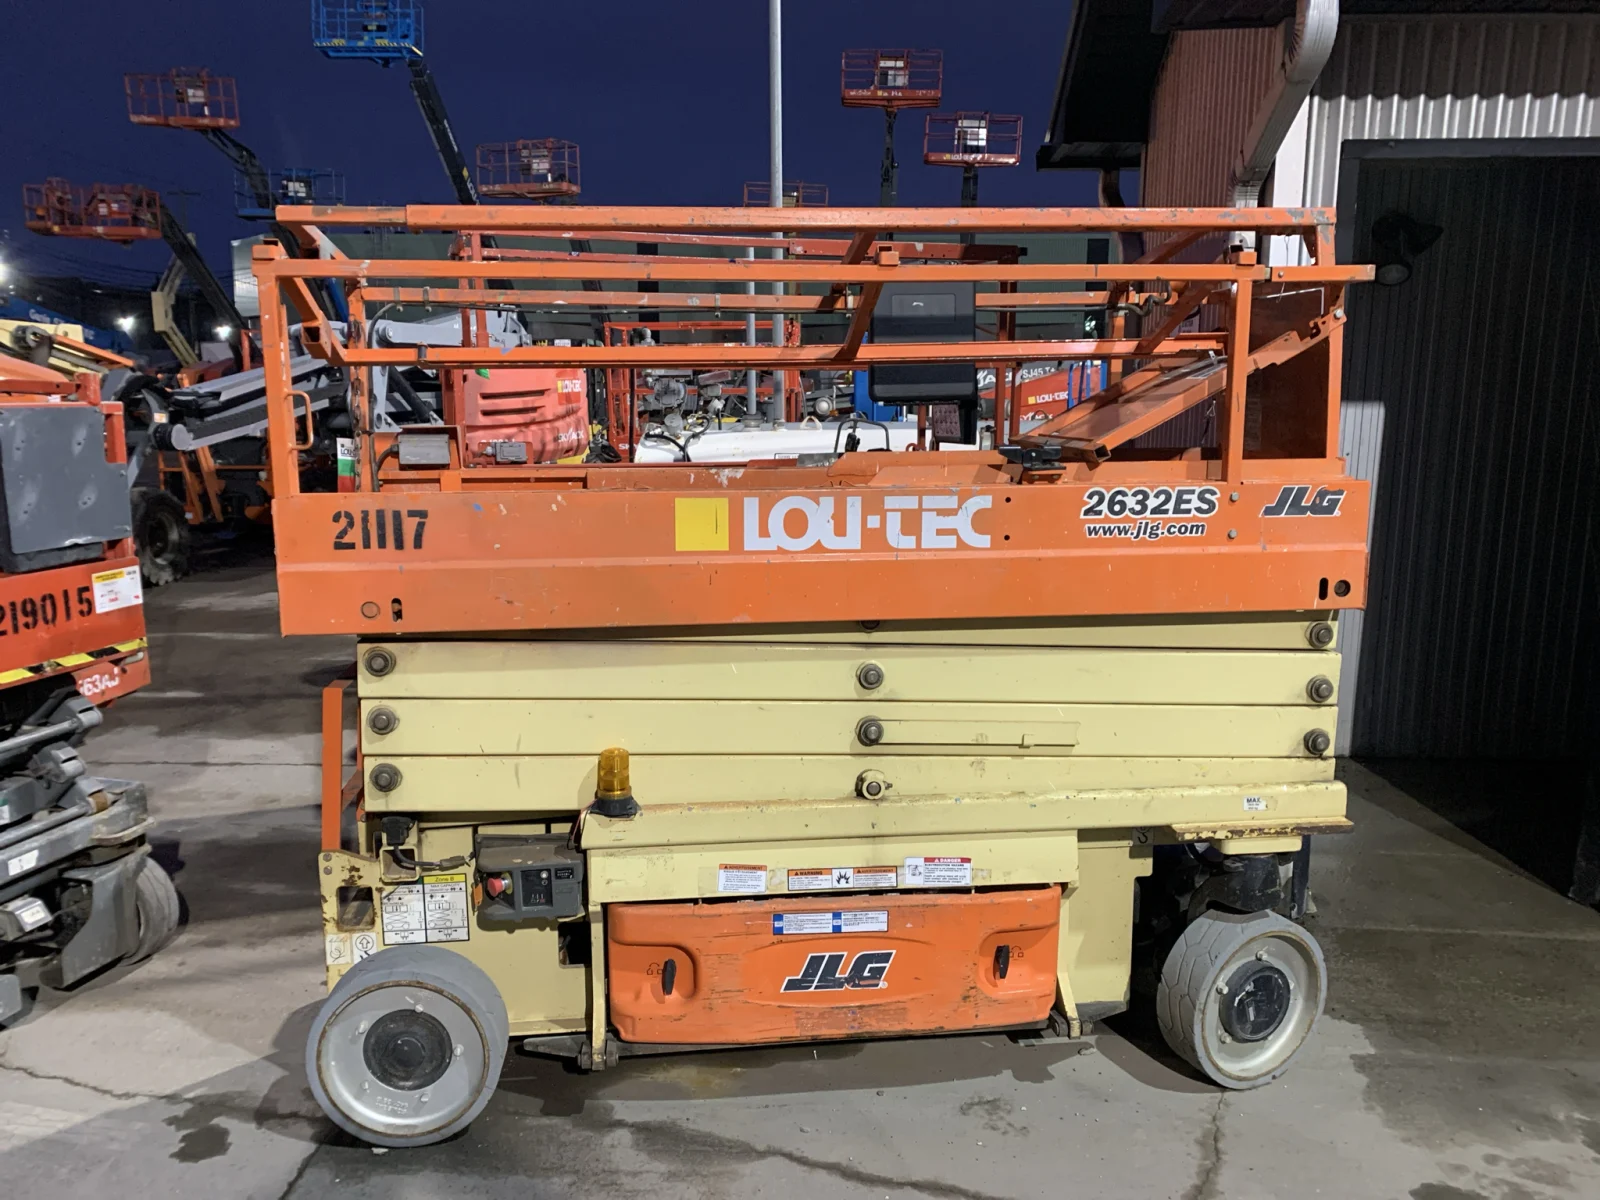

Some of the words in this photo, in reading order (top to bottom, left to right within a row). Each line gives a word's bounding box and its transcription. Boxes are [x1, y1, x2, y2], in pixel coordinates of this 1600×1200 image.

[1022, 367, 1044, 378] SJ45
[1081, 486, 1220, 518] 2632ES
[1259, 485, 1346, 518] JLG
[332, 509, 428, 550] 21117
[744, 495, 993, 551] LOU-TEC
[1086, 521, 1206, 539] www.jlg.com
[779, 949, 897, 993] JLG
